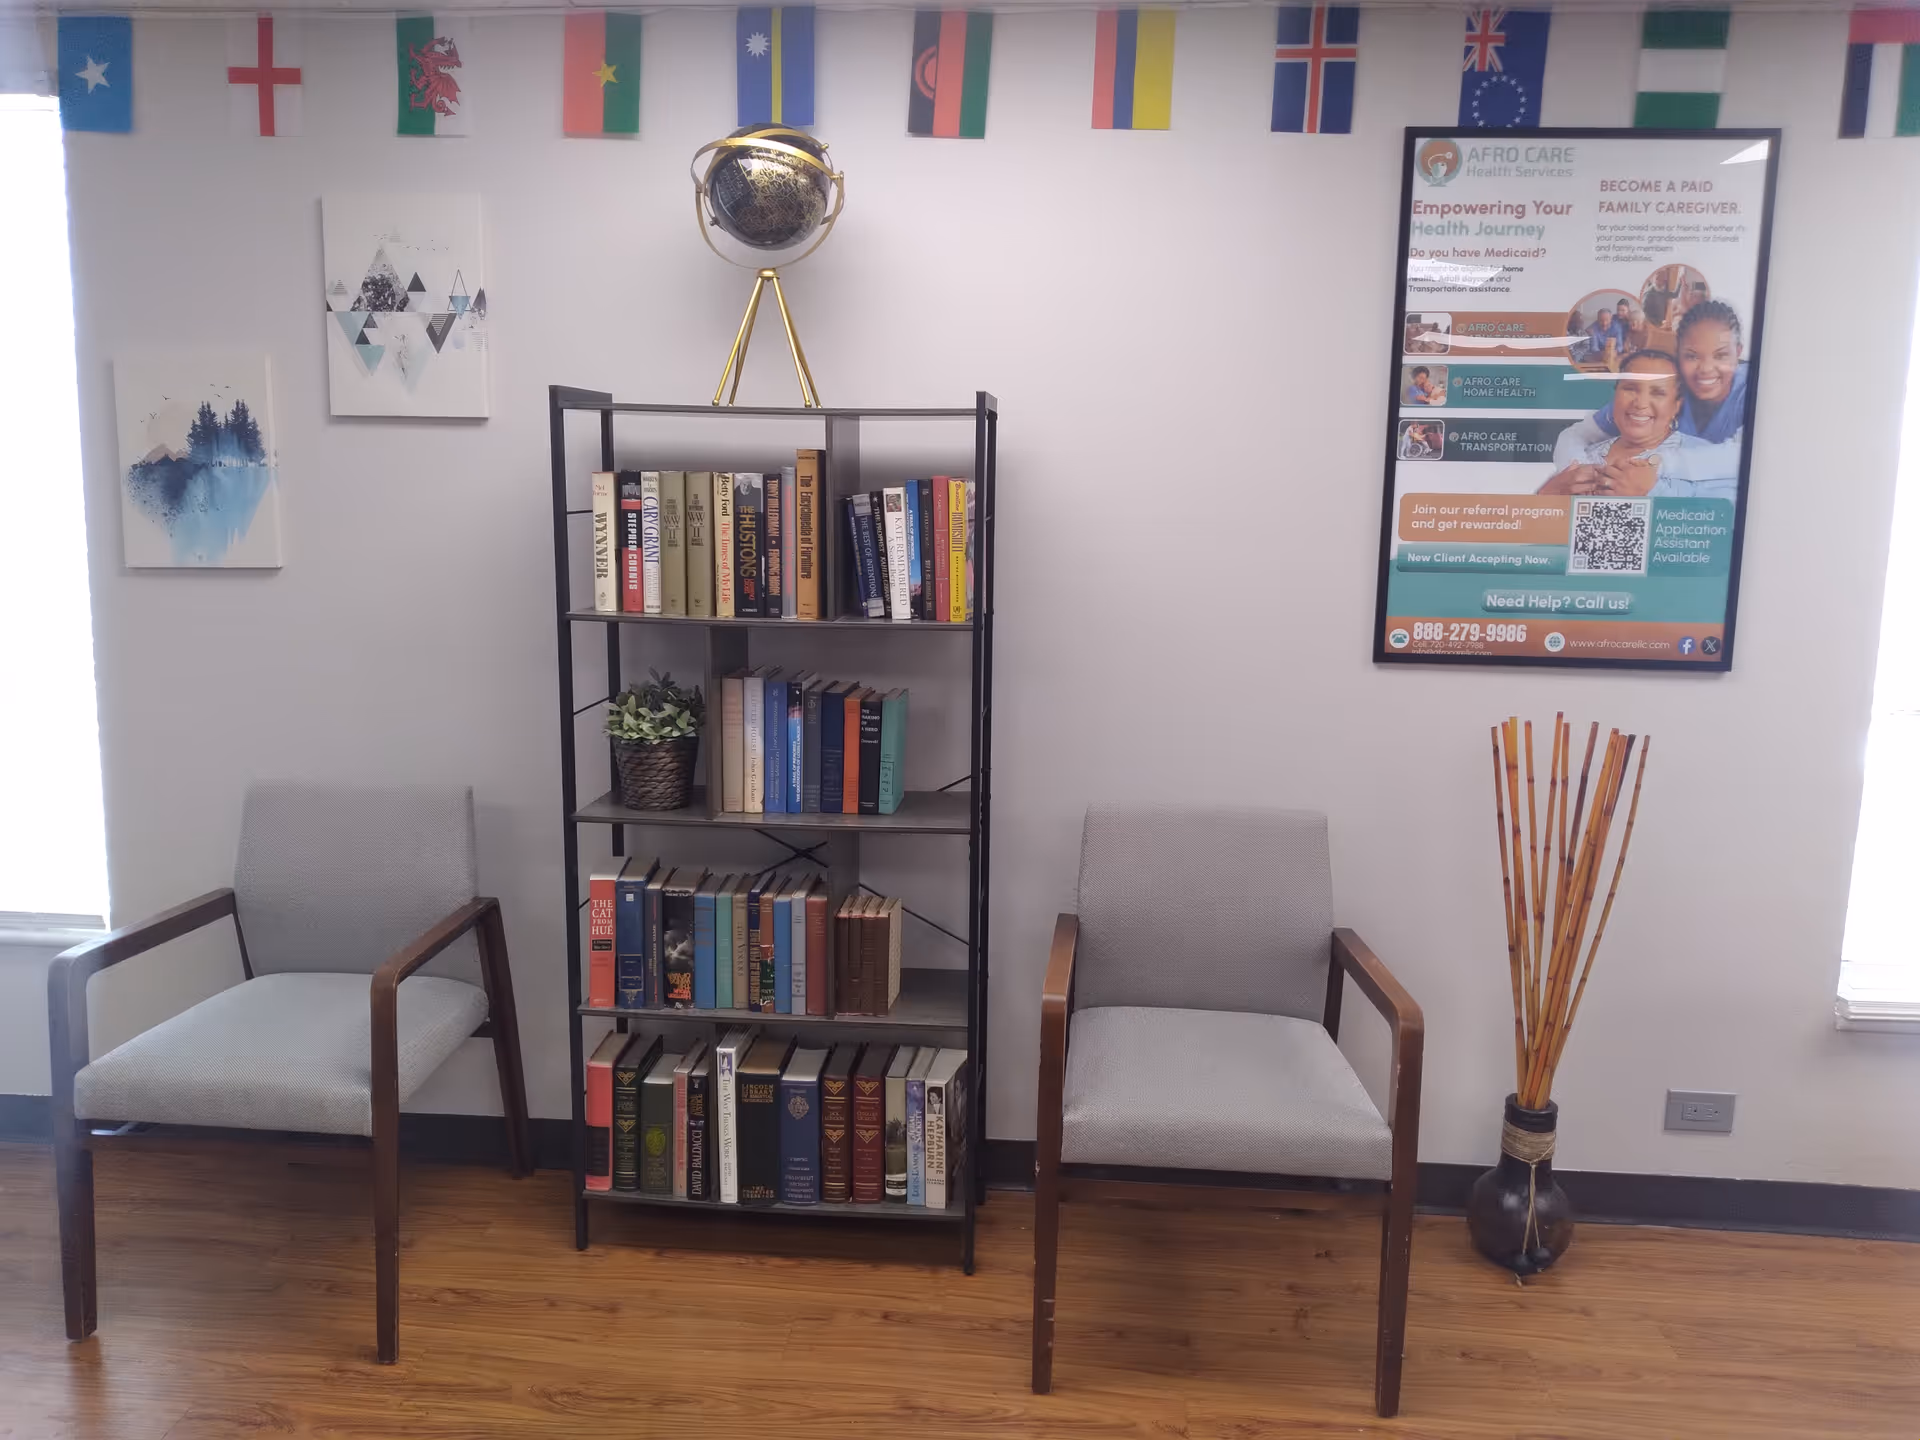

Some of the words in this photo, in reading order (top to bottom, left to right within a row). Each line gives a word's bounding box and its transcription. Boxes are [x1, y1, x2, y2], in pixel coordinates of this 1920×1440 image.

[1467, 147, 1520, 163] AFRO
[1524, 147, 1575, 163] CARE
[1466, 165, 1512, 178] Health
[1515, 166, 1574, 177] Services
[1600, 180, 1662, 193] BECOME
[1665, 181, 1676, 192] A
[1681, 180, 1713, 193] PAID
[1413, 200, 1526, 219] Empowering
[1532, 200, 1573, 215] Your
[1598, 201, 1651, 214] FAMILY
[1410, 221, 1469, 236] Health
[1474, 221, 1546, 240] Journey
[1609, 225, 1626, 233] your
[1596, 234, 1612, 242] your
[1410, 248, 1425, 258] Do
[1429, 249, 1449, 261] you
[1452, 248, 1481, 258] have
[1484, 248, 1546, 258] Medicaid?
[1408, 285, 1467, 294] Transportation
[1469, 285, 1512, 293] assistance.
[1468, 324, 1495, 332] AFRO
[1497, 323, 1525, 331] CARE
[1464, 378, 1492, 386] AFRO
[1494, 378, 1521, 386] CARE
[1463, 388, 1494, 397] HOME
[1497, 388, 1536, 397] HEALTH
[1460, 432, 1487, 441] AFRO
[1490, 432, 1517, 441] CARE
[1460, 442, 1553, 453] TRANSPORTATION
[720, 476, 730, 498] Betty
[767, 479, 778, 496] TONY
[801, 475, 812, 488] The
[643, 496, 659, 526] CARY
[721, 499, 730, 517] Ford
[738, 505, 755, 513] THE
[801, 492, 813, 536] Encyclopedia
[873, 507, 882, 521] THE
[1412, 504, 1437, 515] Join
[1439, 506, 1460, 515] our
[1463, 504, 1508, 516] referral
[1511, 507, 1564, 519] program
[1656, 508, 1715, 521] Medicaid
[721, 521, 730, 538] The
[860, 516, 869, 530] THE
[895, 517, 904, 542] KATE
[1412, 519, 1435, 529] and
[1437, 520, 1458, 532] get
[1460, 519, 1522, 530] rewarded!
[1656, 522, 1727, 537] Application
[628, 513, 638, 551] STEPHEN
[862, 531, 871, 546] BEST
[875, 522, 886, 552] PROPHET
[595, 512, 609, 579] WYNNER
[644, 526, 660, 564] GRANT
[721, 538, 730, 561] Times
[740, 515, 756, 577] HUSTONS
[802, 537, 813, 545] of
[1654, 537, 1710, 549] Assistant
[864, 548, 872, 557] OF
[888, 545, 897, 566] Scott
[1407, 553, 1431, 562] New
[1433, 553, 1466, 563] Client
[1468, 553, 1522, 566] Accepting
[1653, 551, 1710, 563] Available
[721, 561, 730, 571] of
[801, 546, 814, 579] Furniture
[628, 553, 638, 590] COONTS
[722, 572, 731, 587] My
[865, 558, 878, 598] INTENTIONS
[889, 567, 898, 587] Berg
[897, 543, 908, 605] REMEMBERED
[769, 575, 780, 596] MOON
[722, 587, 731, 604] Life
[1486, 594, 1525, 607] Need
[1528, 595, 1571, 611] Help?
[1575, 596, 1604, 610] Call
[1608, 597, 1630, 610] us!
[1413, 622, 1527, 642] 888-279-9986
[1430, 641, 1484, 649] 720-492-7988
[592, 899, 613, 908] THE
[592, 909, 613, 918] CAT
[722, 1078, 730, 1092] THE
[723, 1093, 731, 1110] WAY
[723, 1112, 732, 1137] THINGS
[914, 1110, 922, 1144] SACKETT
[692, 1130, 703, 1168] BALDACCI
[724, 1137, 732, 1160] WORK
[926, 1121, 935, 1169] HEPBURN
[936, 1116, 944, 1175] KATHARINE
[692, 1170, 702, 1195] DAVID
[911, 1177, 920, 1198] LOUIS
